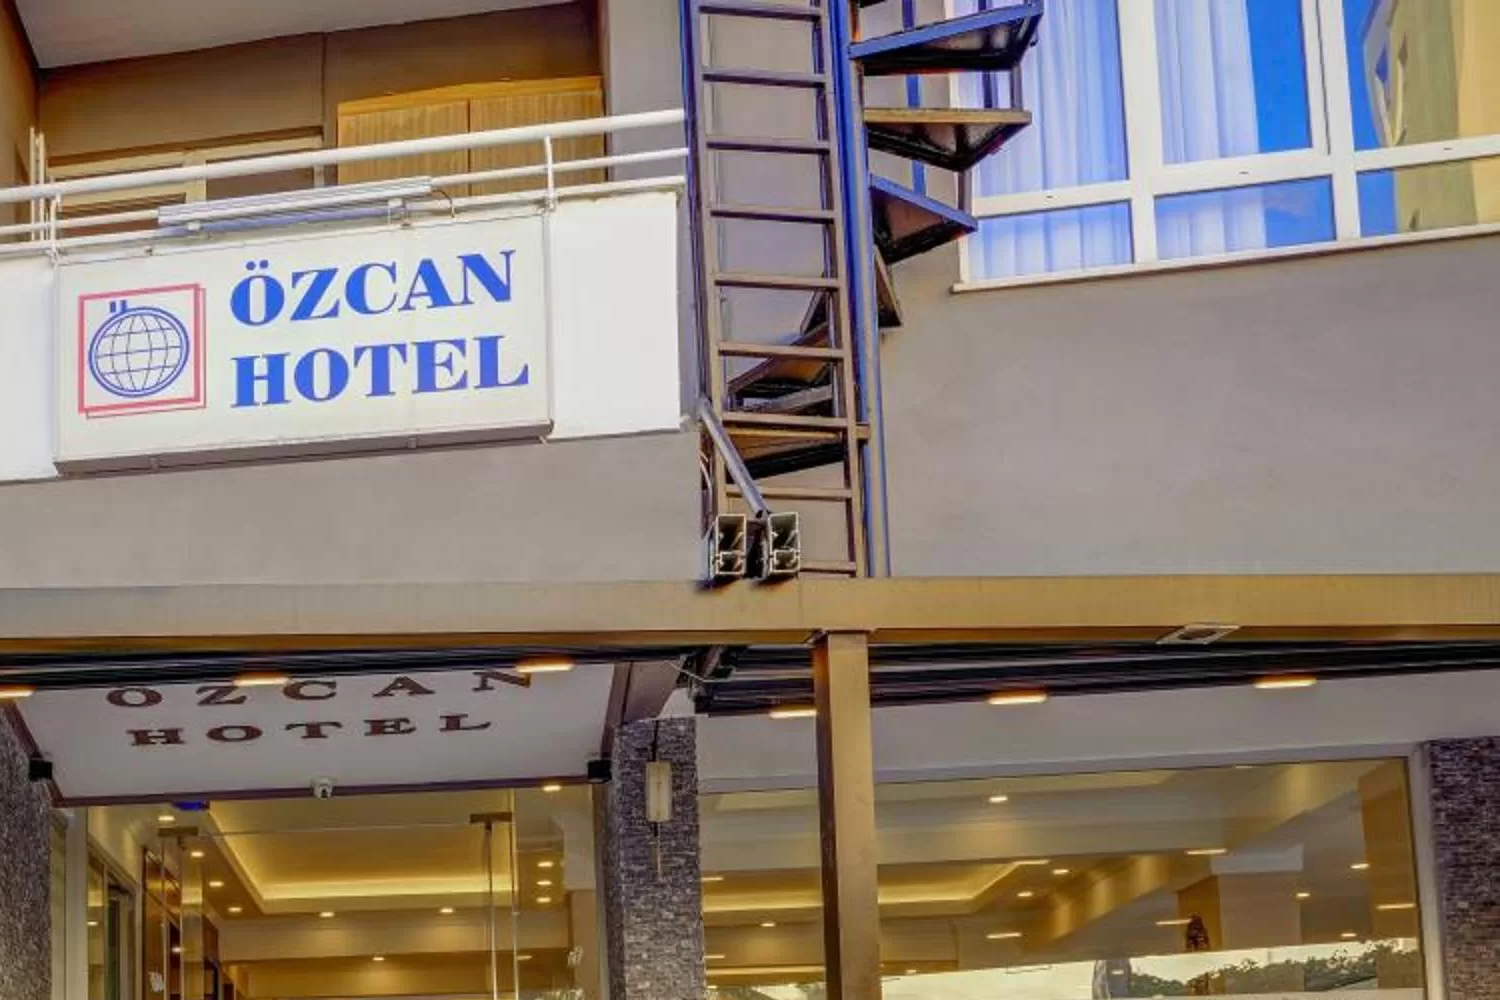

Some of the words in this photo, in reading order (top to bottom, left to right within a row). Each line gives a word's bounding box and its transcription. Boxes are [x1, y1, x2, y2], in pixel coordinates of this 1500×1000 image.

[230, 251, 516, 327] ÖZCAN
[230, 335, 530, 409] HOTEL
[127, 713, 492, 747] HOTEL
